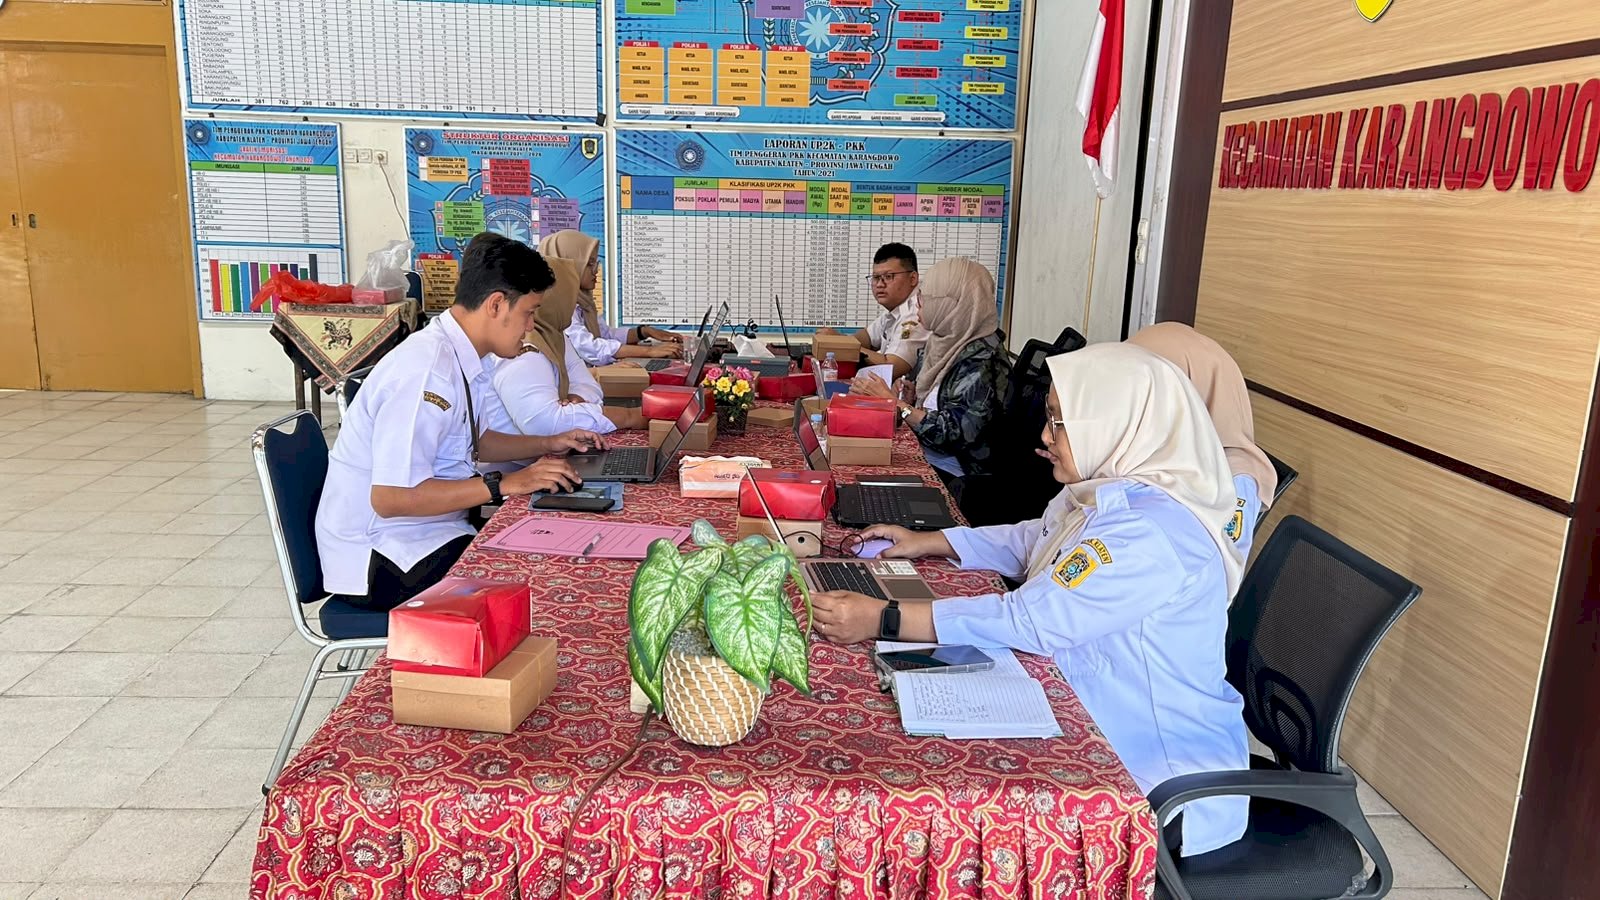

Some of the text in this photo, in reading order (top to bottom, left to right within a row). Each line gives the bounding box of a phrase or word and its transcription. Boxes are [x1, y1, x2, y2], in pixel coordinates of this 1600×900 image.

[764, 139, 807, 148] LAPORAN
[811, 141, 835, 150] UP2K
[846, 142, 865, 151] PKK
[1218, 78, 1600, 192] KECAMATAN KARANGDOWO
